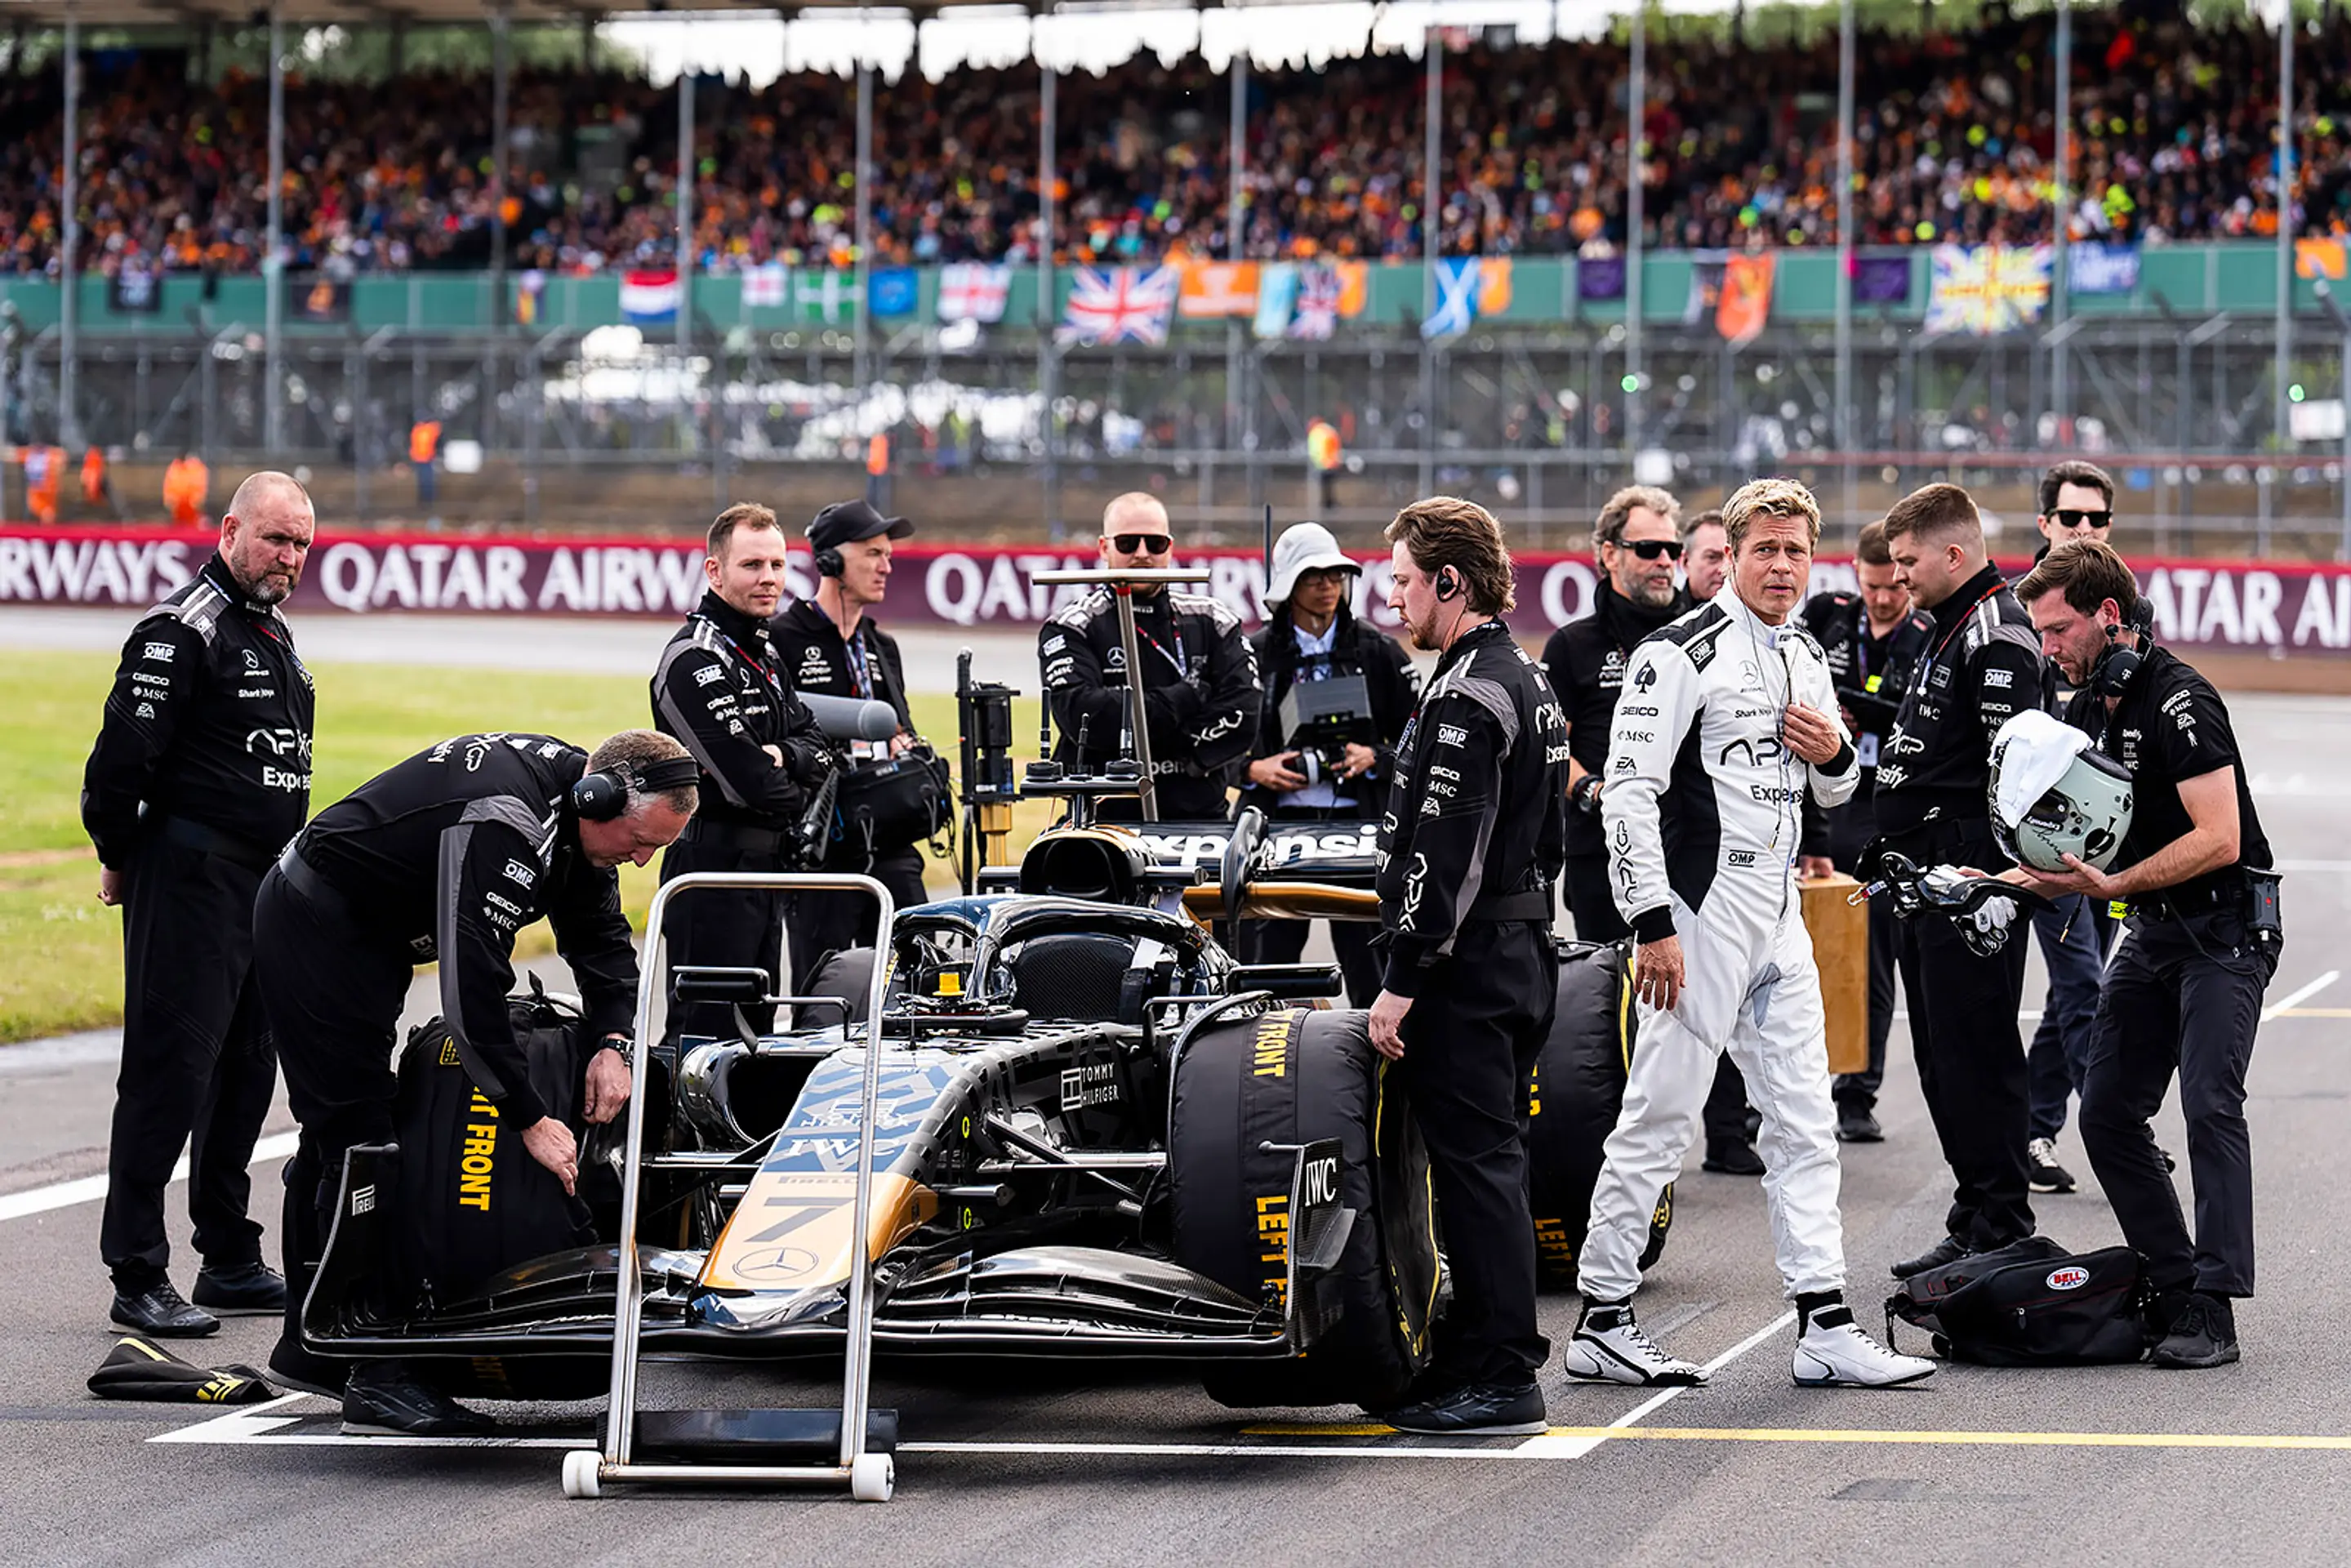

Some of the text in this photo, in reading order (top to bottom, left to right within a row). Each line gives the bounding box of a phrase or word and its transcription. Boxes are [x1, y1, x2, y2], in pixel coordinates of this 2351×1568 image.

[321, 542, 529, 612] QATAR
[2144, 567, 2284, 645] ATAR
[144, 644, 175, 661] OMP
[1690, 640, 1712, 662] OMP
[132, 672, 170, 686] GEICO
[1984, 670, 2014, 687] OMP
[143, 688, 168, 701] MSC
[1620, 706, 1659, 717] GEICO
[1437, 725, 1467, 746] OMP
[1625, 730, 1654, 742] MSC
[1616, 756, 1636, 769] EA
[1728, 851, 1756, 866] OMP
[504, 861, 535, 887] OMP
[487, 892, 522, 915] GEICO
[491, 911, 517, 930] MSC
[1253, 1022, 1290, 1077] FRONT
[1081, 1062, 1115, 1083] TOMMY
[1080, 1085, 1120, 1106] HILFIGER
[460, 1125, 497, 1211] FRONT
[1305, 1157, 1337, 1207] IWC
[743, 1197, 857, 1242] 7
[1257, 1195, 1288, 1265] LEFT
[1534, 1218, 1572, 1260] LEFT
[2054, 1271, 2082, 1284] BELL
